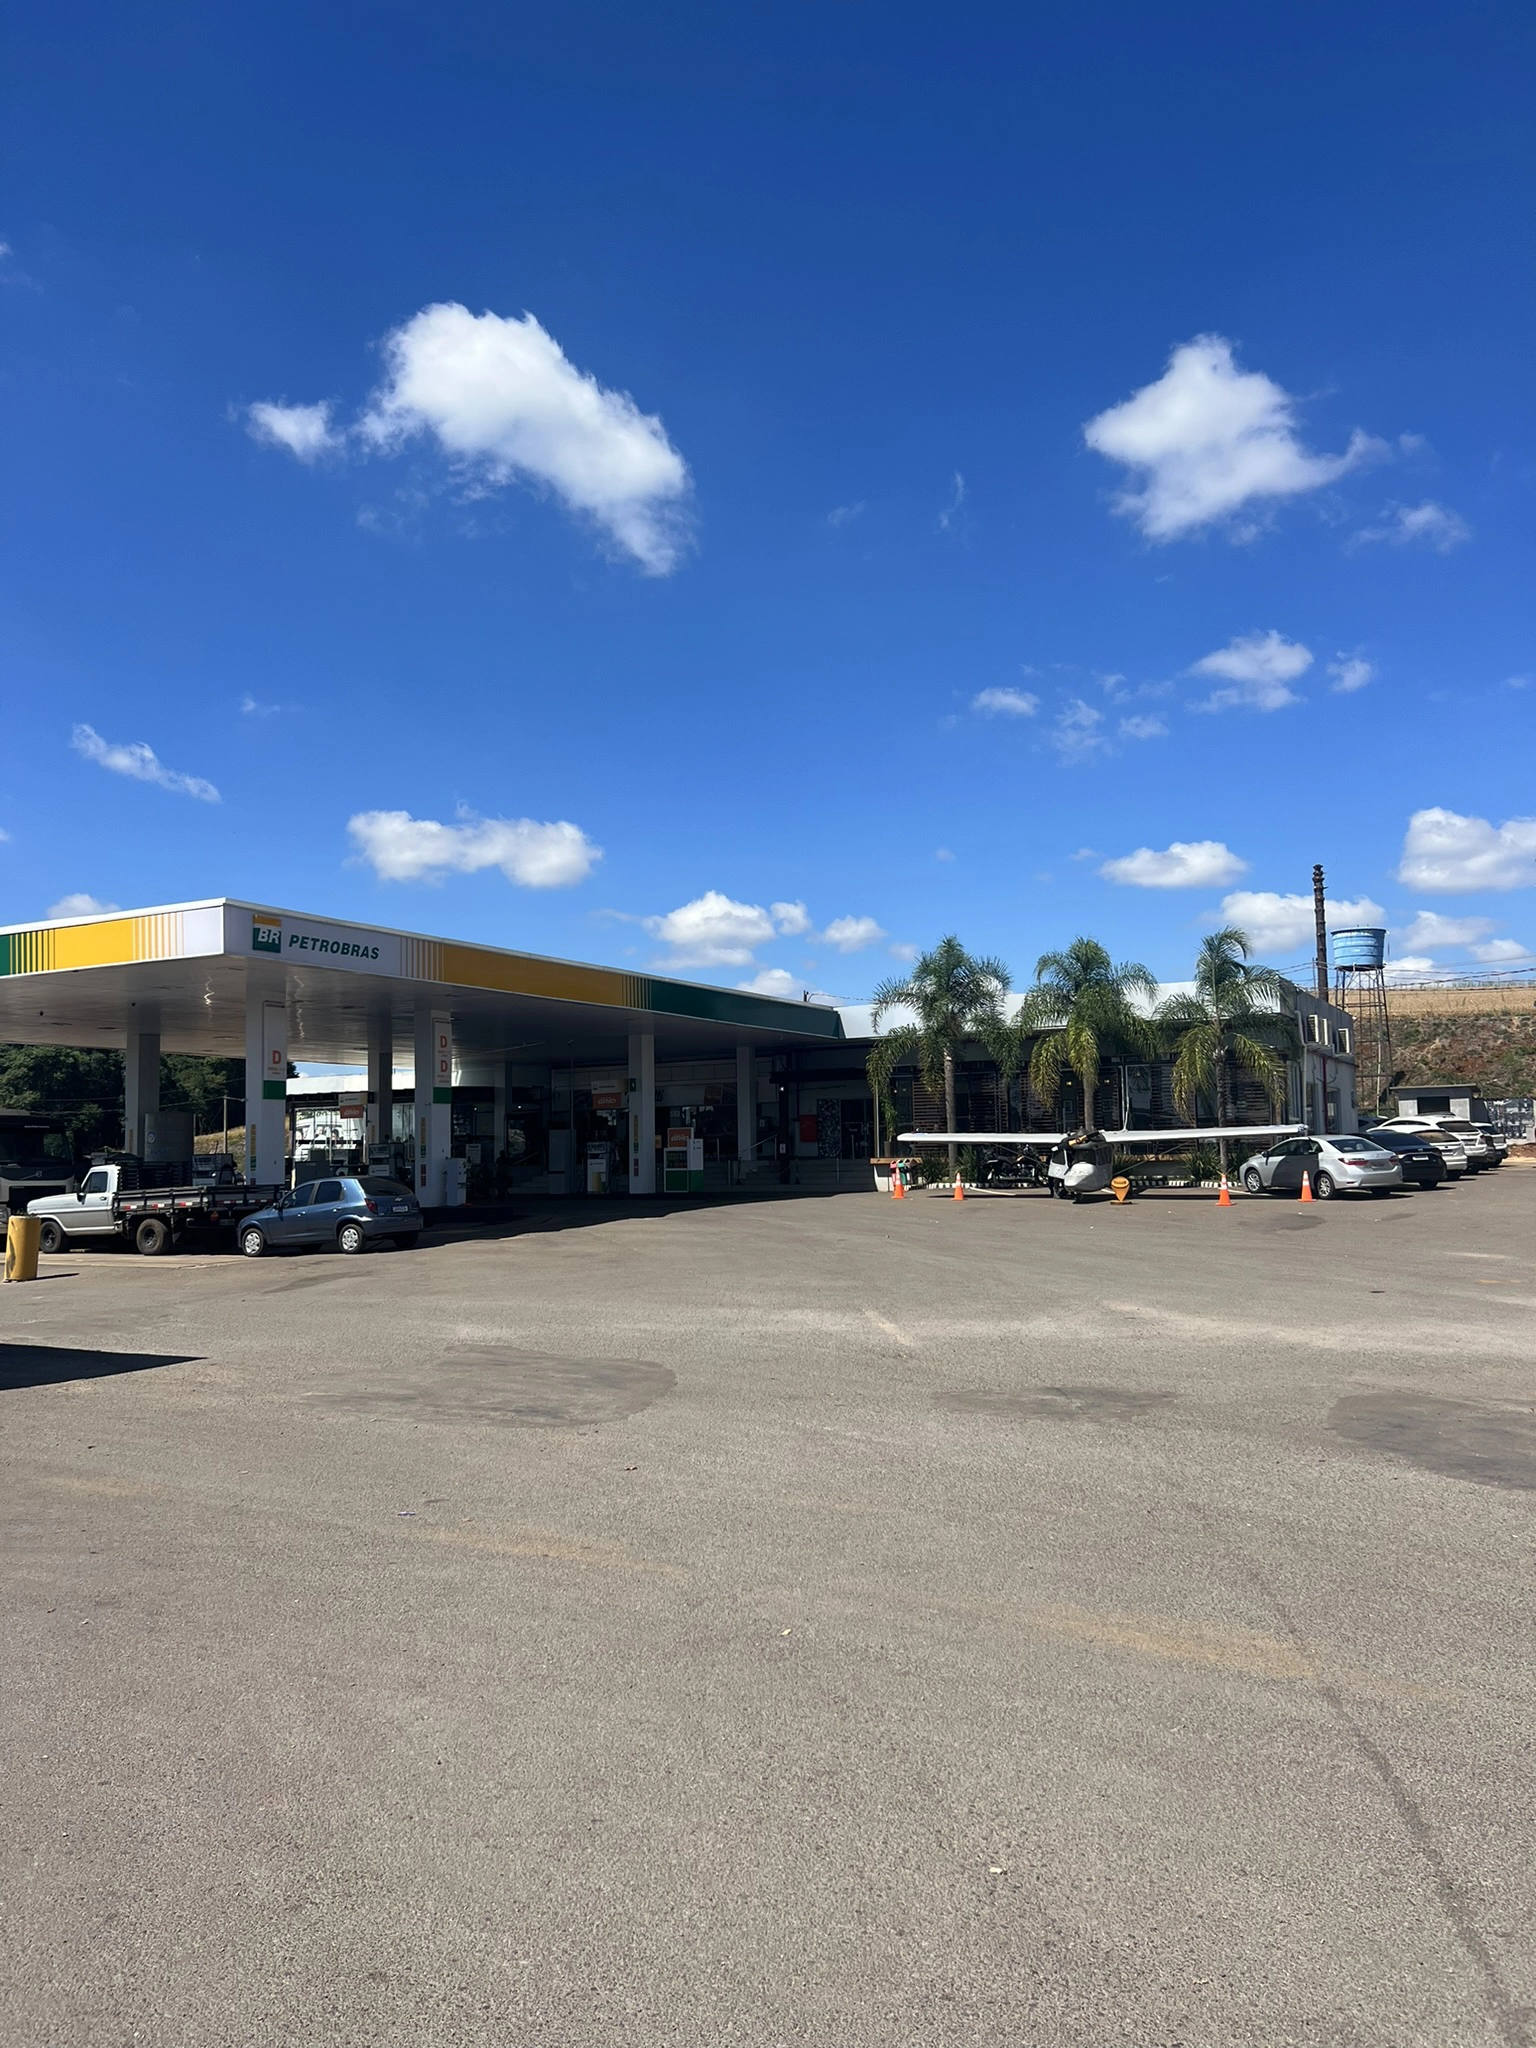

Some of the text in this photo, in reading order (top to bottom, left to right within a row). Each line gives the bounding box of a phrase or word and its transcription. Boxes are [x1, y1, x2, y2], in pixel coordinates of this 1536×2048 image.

[257, 928, 380, 960] BR PETROBRAS
[440, 1035, 448, 1049] D
[272, 1050, 281, 1065] D
[440, 1060, 448, 1073] D
